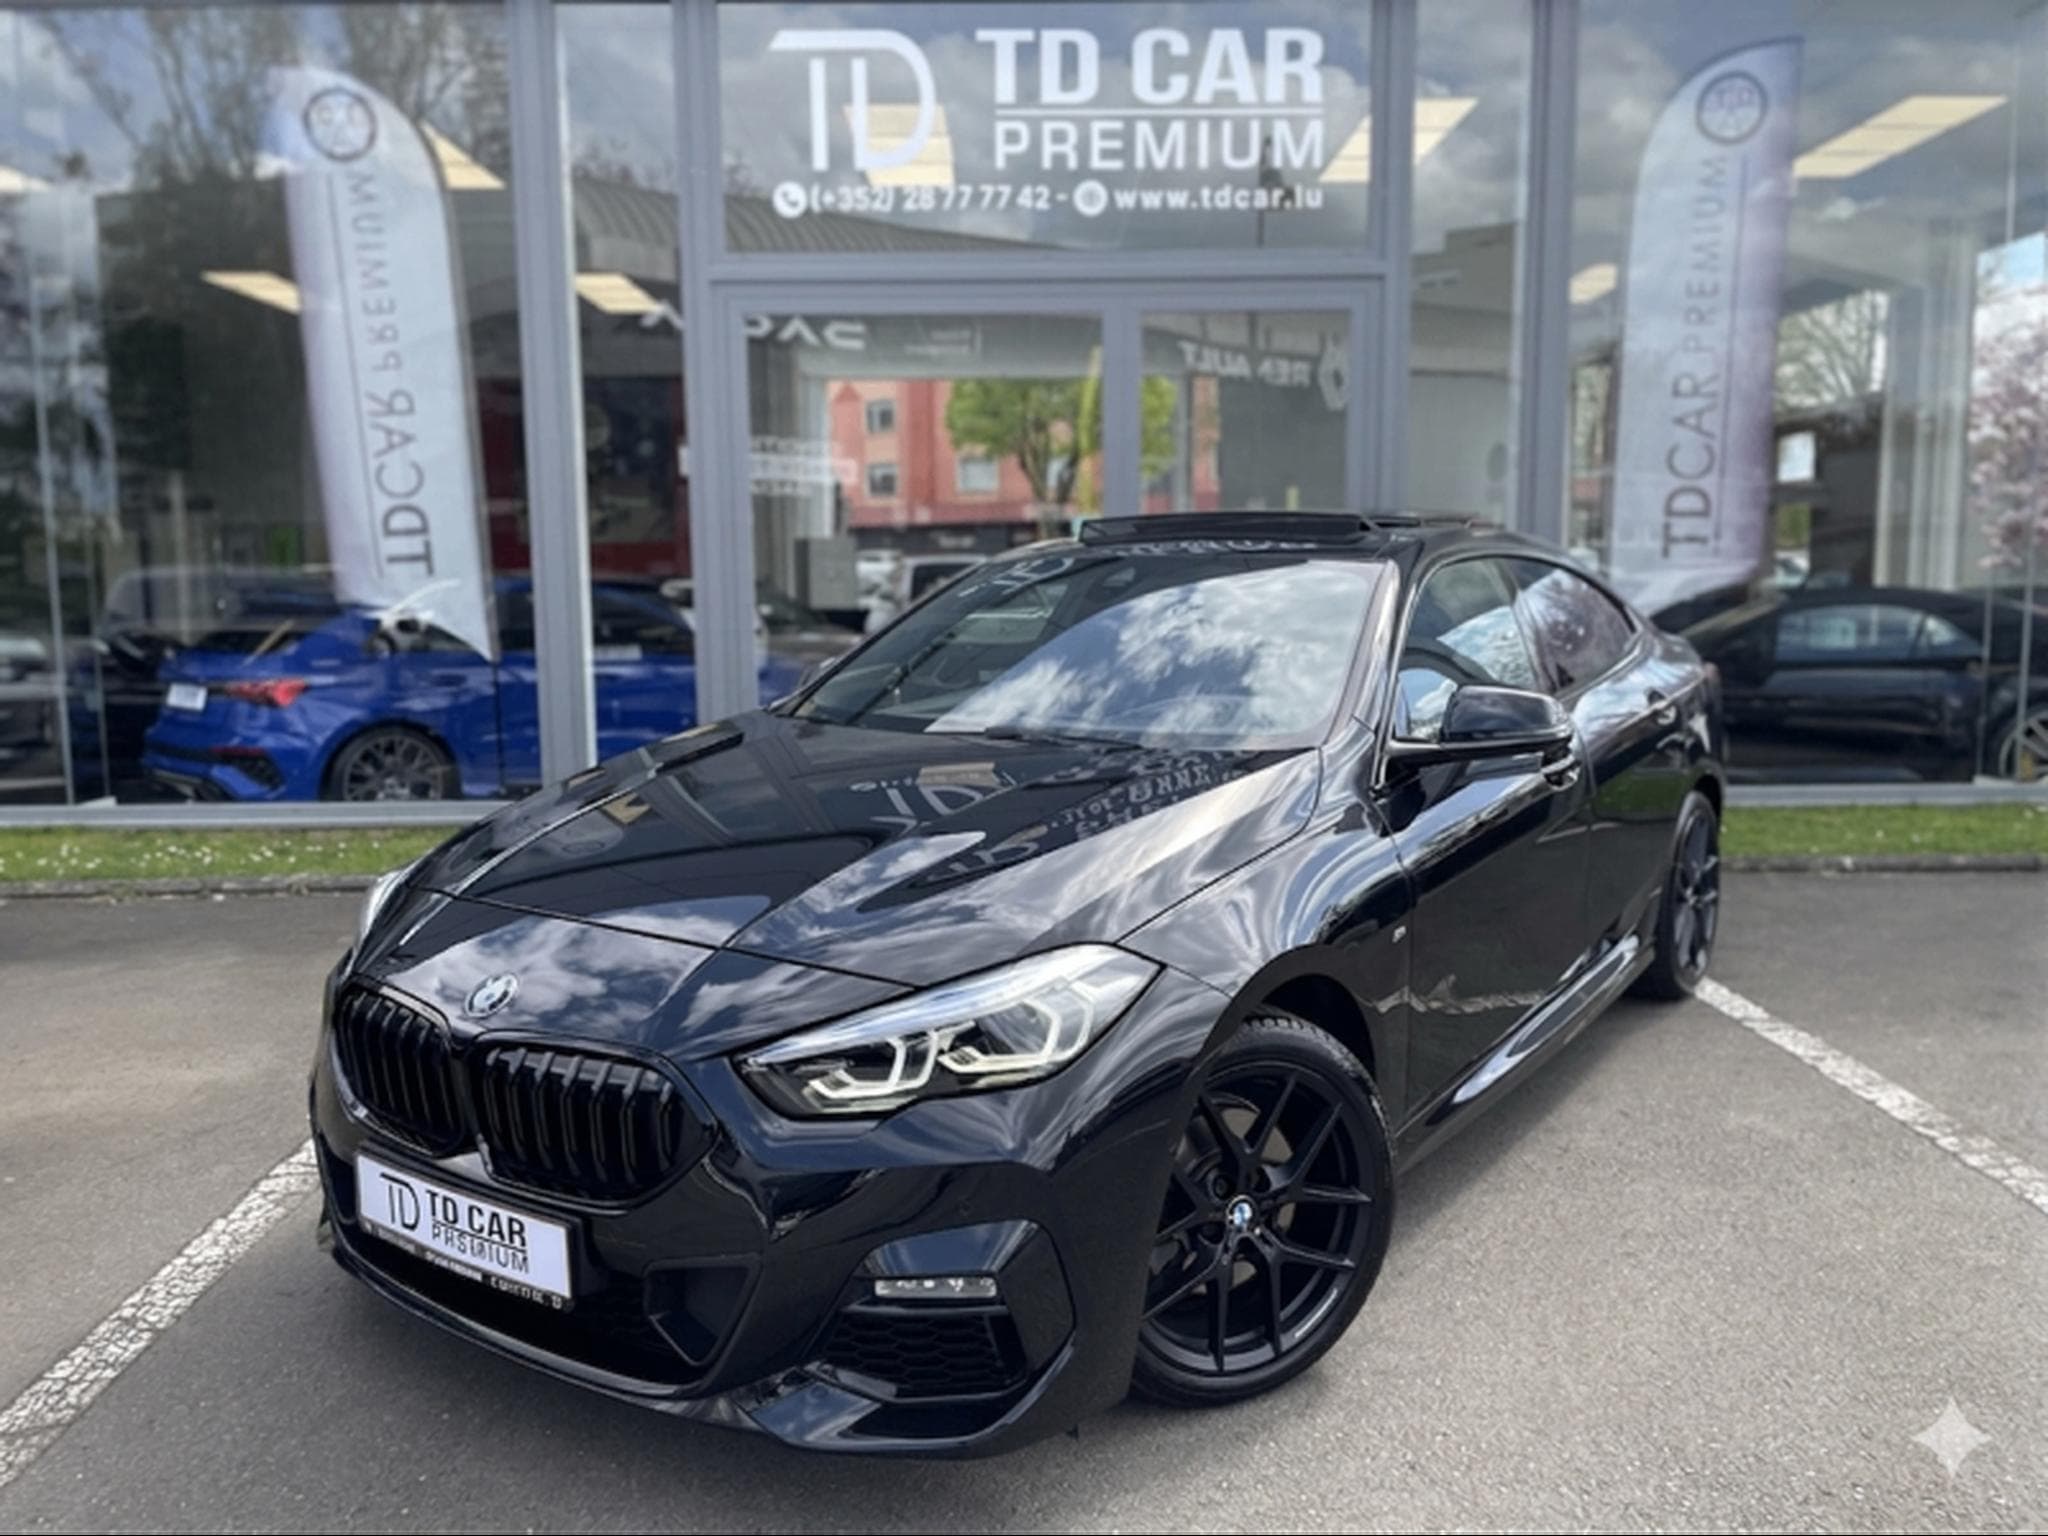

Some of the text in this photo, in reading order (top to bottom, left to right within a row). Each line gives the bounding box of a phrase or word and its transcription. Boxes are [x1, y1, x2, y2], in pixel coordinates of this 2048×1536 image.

[975, 28, 1325, 104] TD CAR
[995, 120, 1325, 171] PREMIUM
[1113, 182, 1325, 212] www.tdcar.lu
[1662, 154, 1729, 558] TDCAR PREMIUM
[425, 1188, 526, 1248] TD CAR
